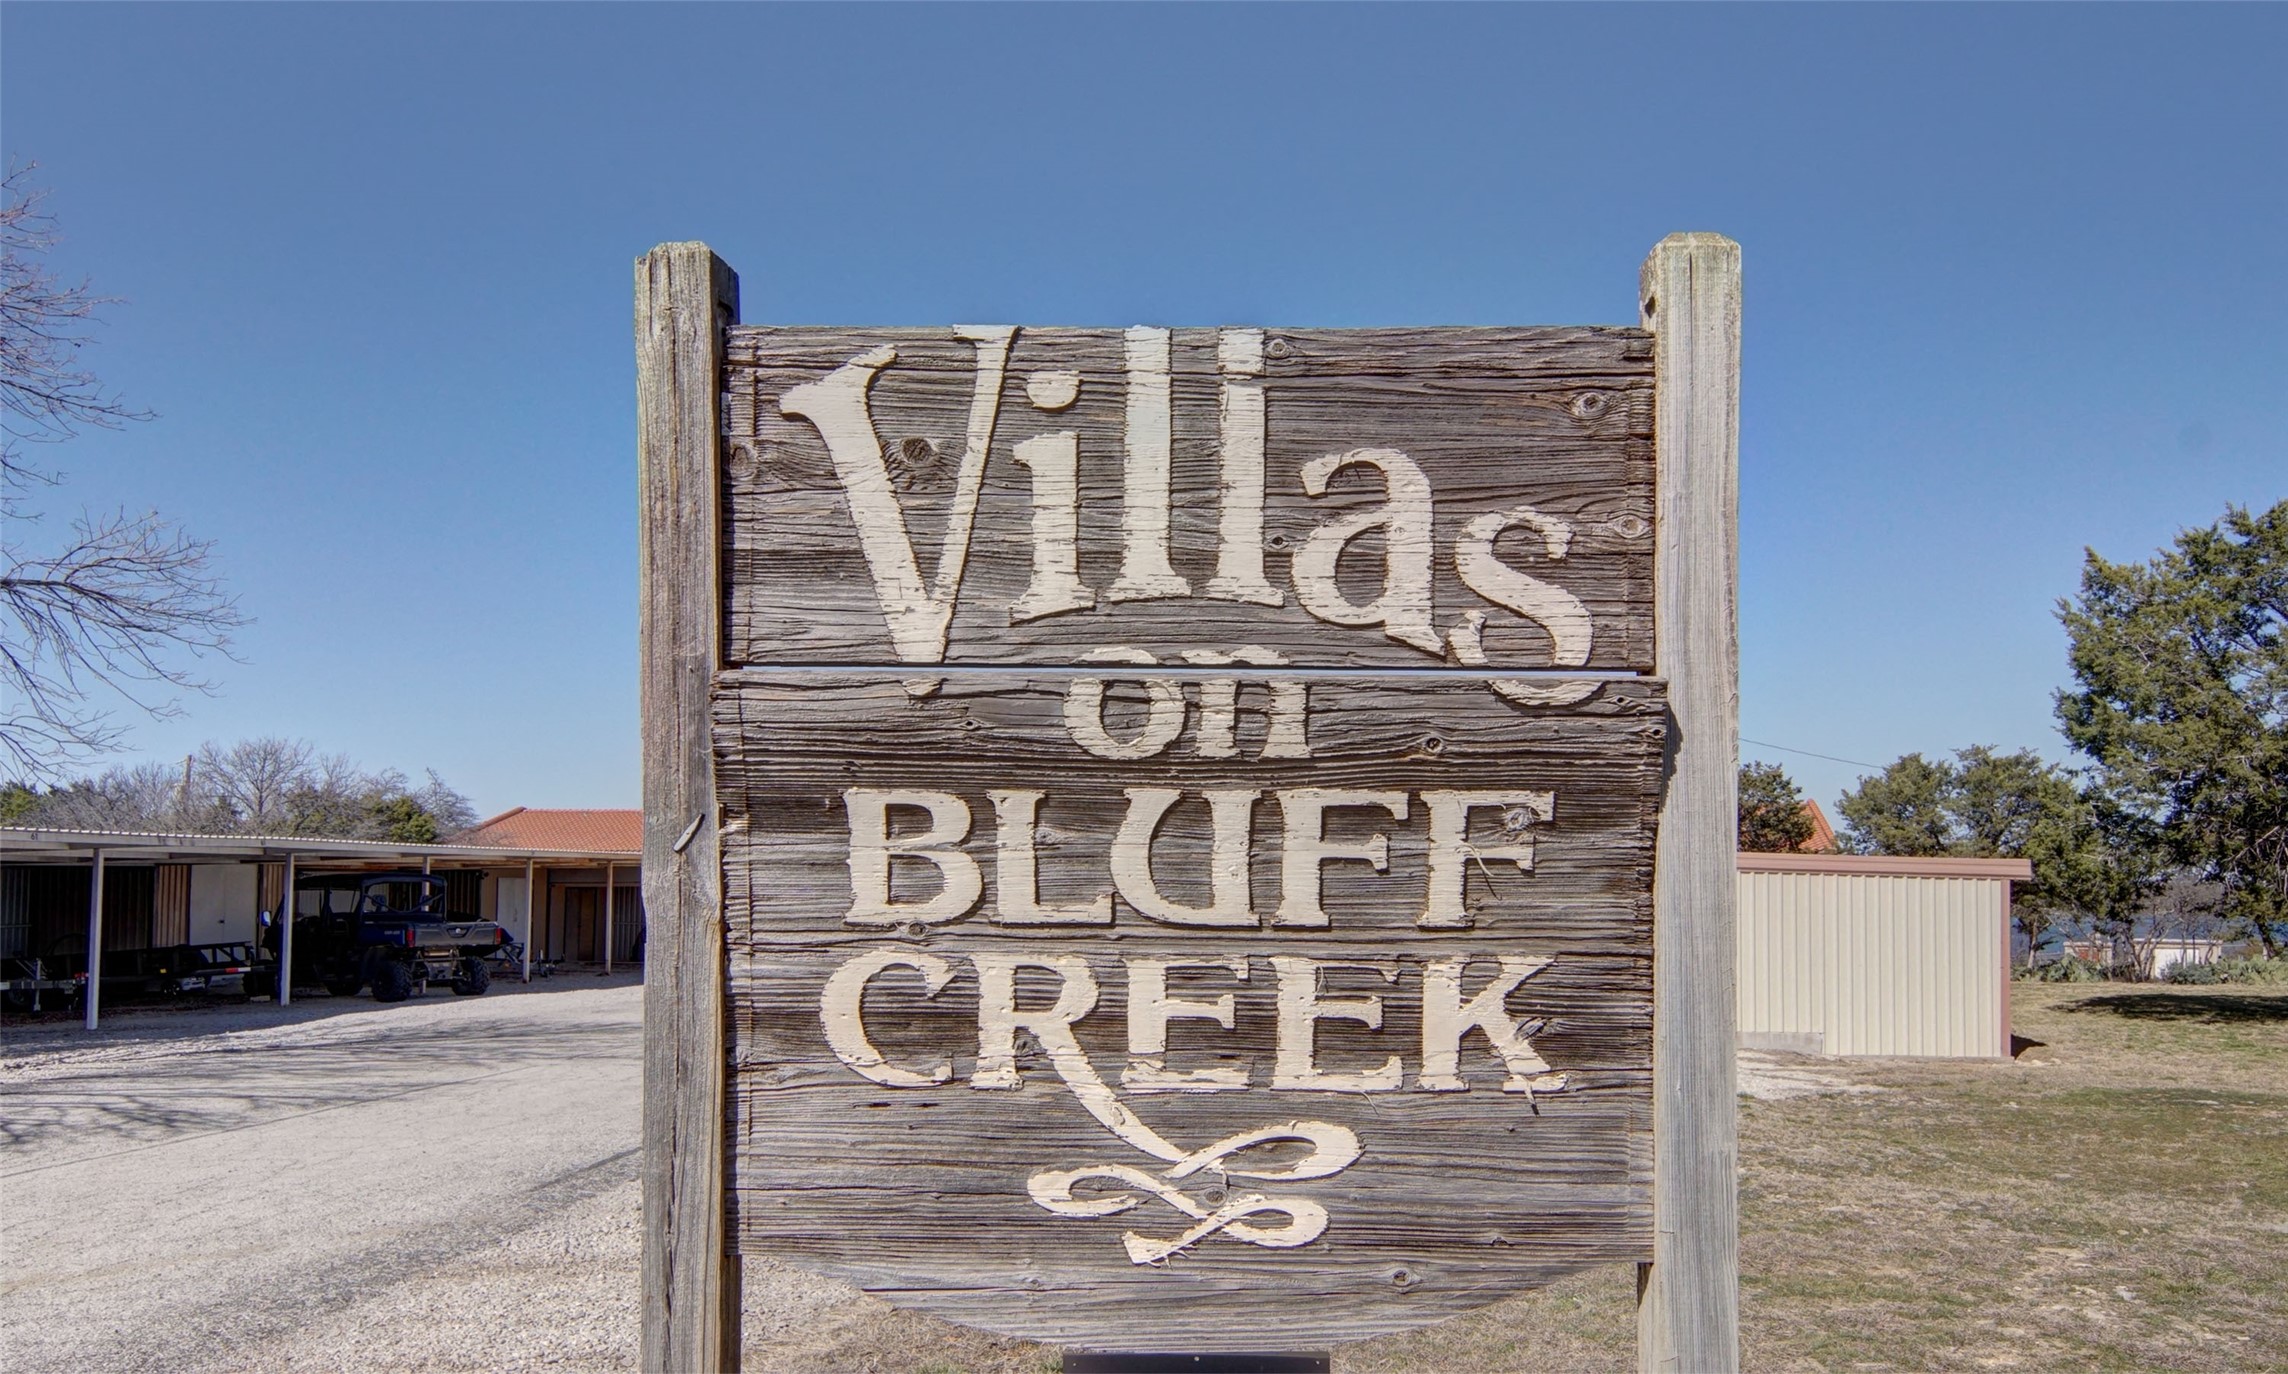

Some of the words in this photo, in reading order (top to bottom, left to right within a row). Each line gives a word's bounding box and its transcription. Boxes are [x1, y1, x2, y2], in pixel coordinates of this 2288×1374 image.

[780, 324, 1602, 706] Villas
[1063, 646, 1311, 762] on
[842, 787, 1556, 929] BLUFF
[820, 948, 1568, 1162] CREEK
